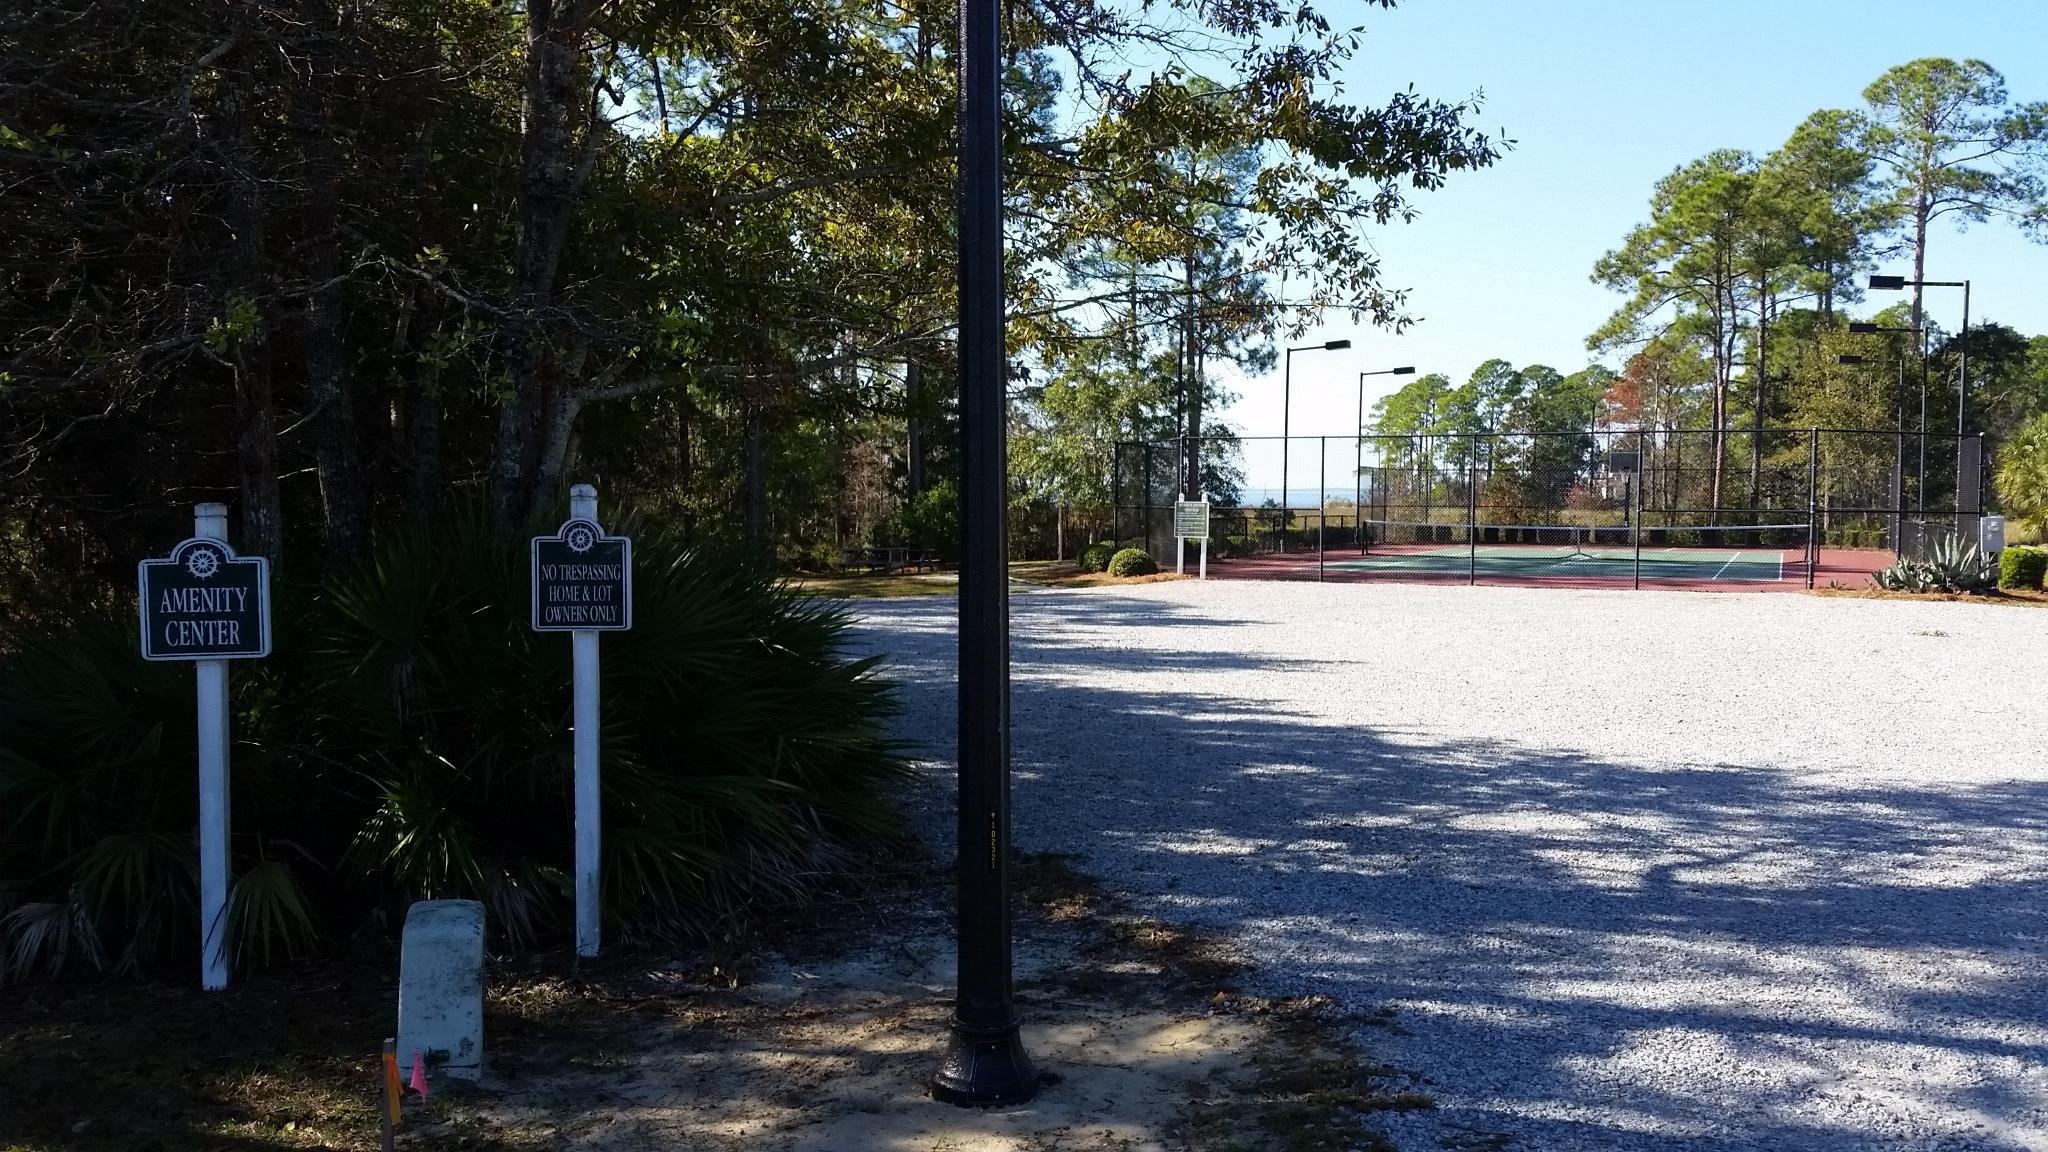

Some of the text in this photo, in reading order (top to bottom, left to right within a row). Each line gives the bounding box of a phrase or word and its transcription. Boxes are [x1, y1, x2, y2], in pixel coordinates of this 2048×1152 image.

[542, 564, 621, 581] NO TRESPASSING
[160, 586, 248, 613] AMENITY
[549, 585, 613, 602] HOME & LOT
[545, 605, 617, 622] OWNERS ONLY
[165, 620, 241, 646] CENTER
